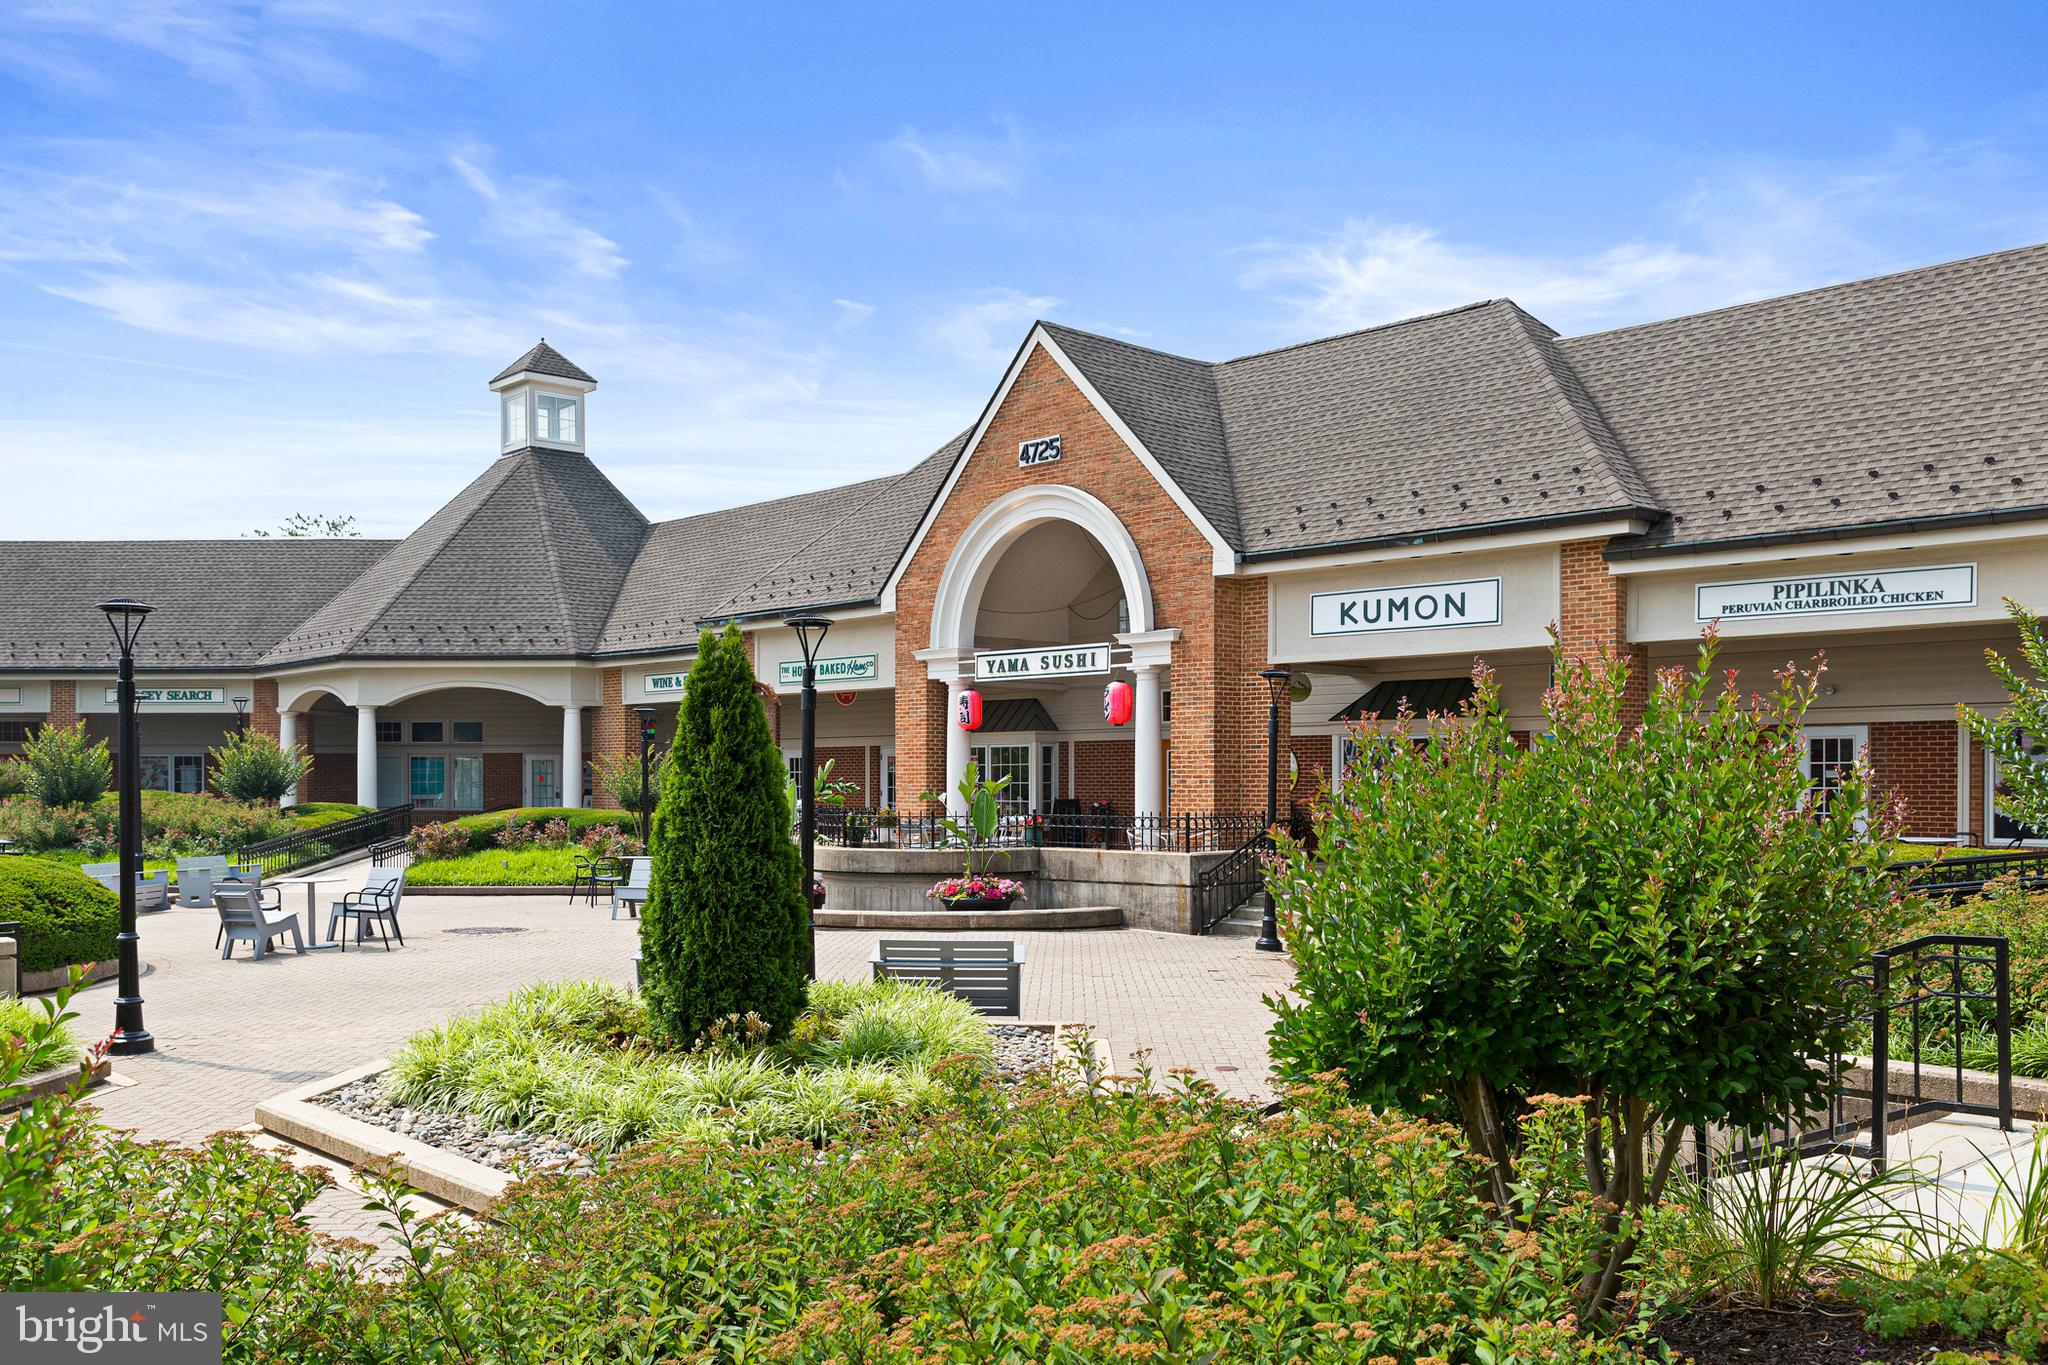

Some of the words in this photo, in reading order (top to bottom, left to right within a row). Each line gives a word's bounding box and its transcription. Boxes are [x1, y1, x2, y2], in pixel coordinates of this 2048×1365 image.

[1020, 437, 1060, 464] 4725
[1772, 577, 1885, 600] PIPILINKA
[1340, 592, 1466, 626] KUMON
[1722, 601, 1782, 614] PERUVIAN
[1785, 595, 1878, 610] CHARBROILED
[1881, 591, 1944, 604] CHICKEN
[820, 662, 845, 675] BAKED
[986, 658, 1030, 674] YAMA
[1041, 652, 1096, 670] SUSHI
[652, 677, 673, 688] WINE
[675, 676, 682, 688] &
[166, 690, 212, 700] SEARCH
